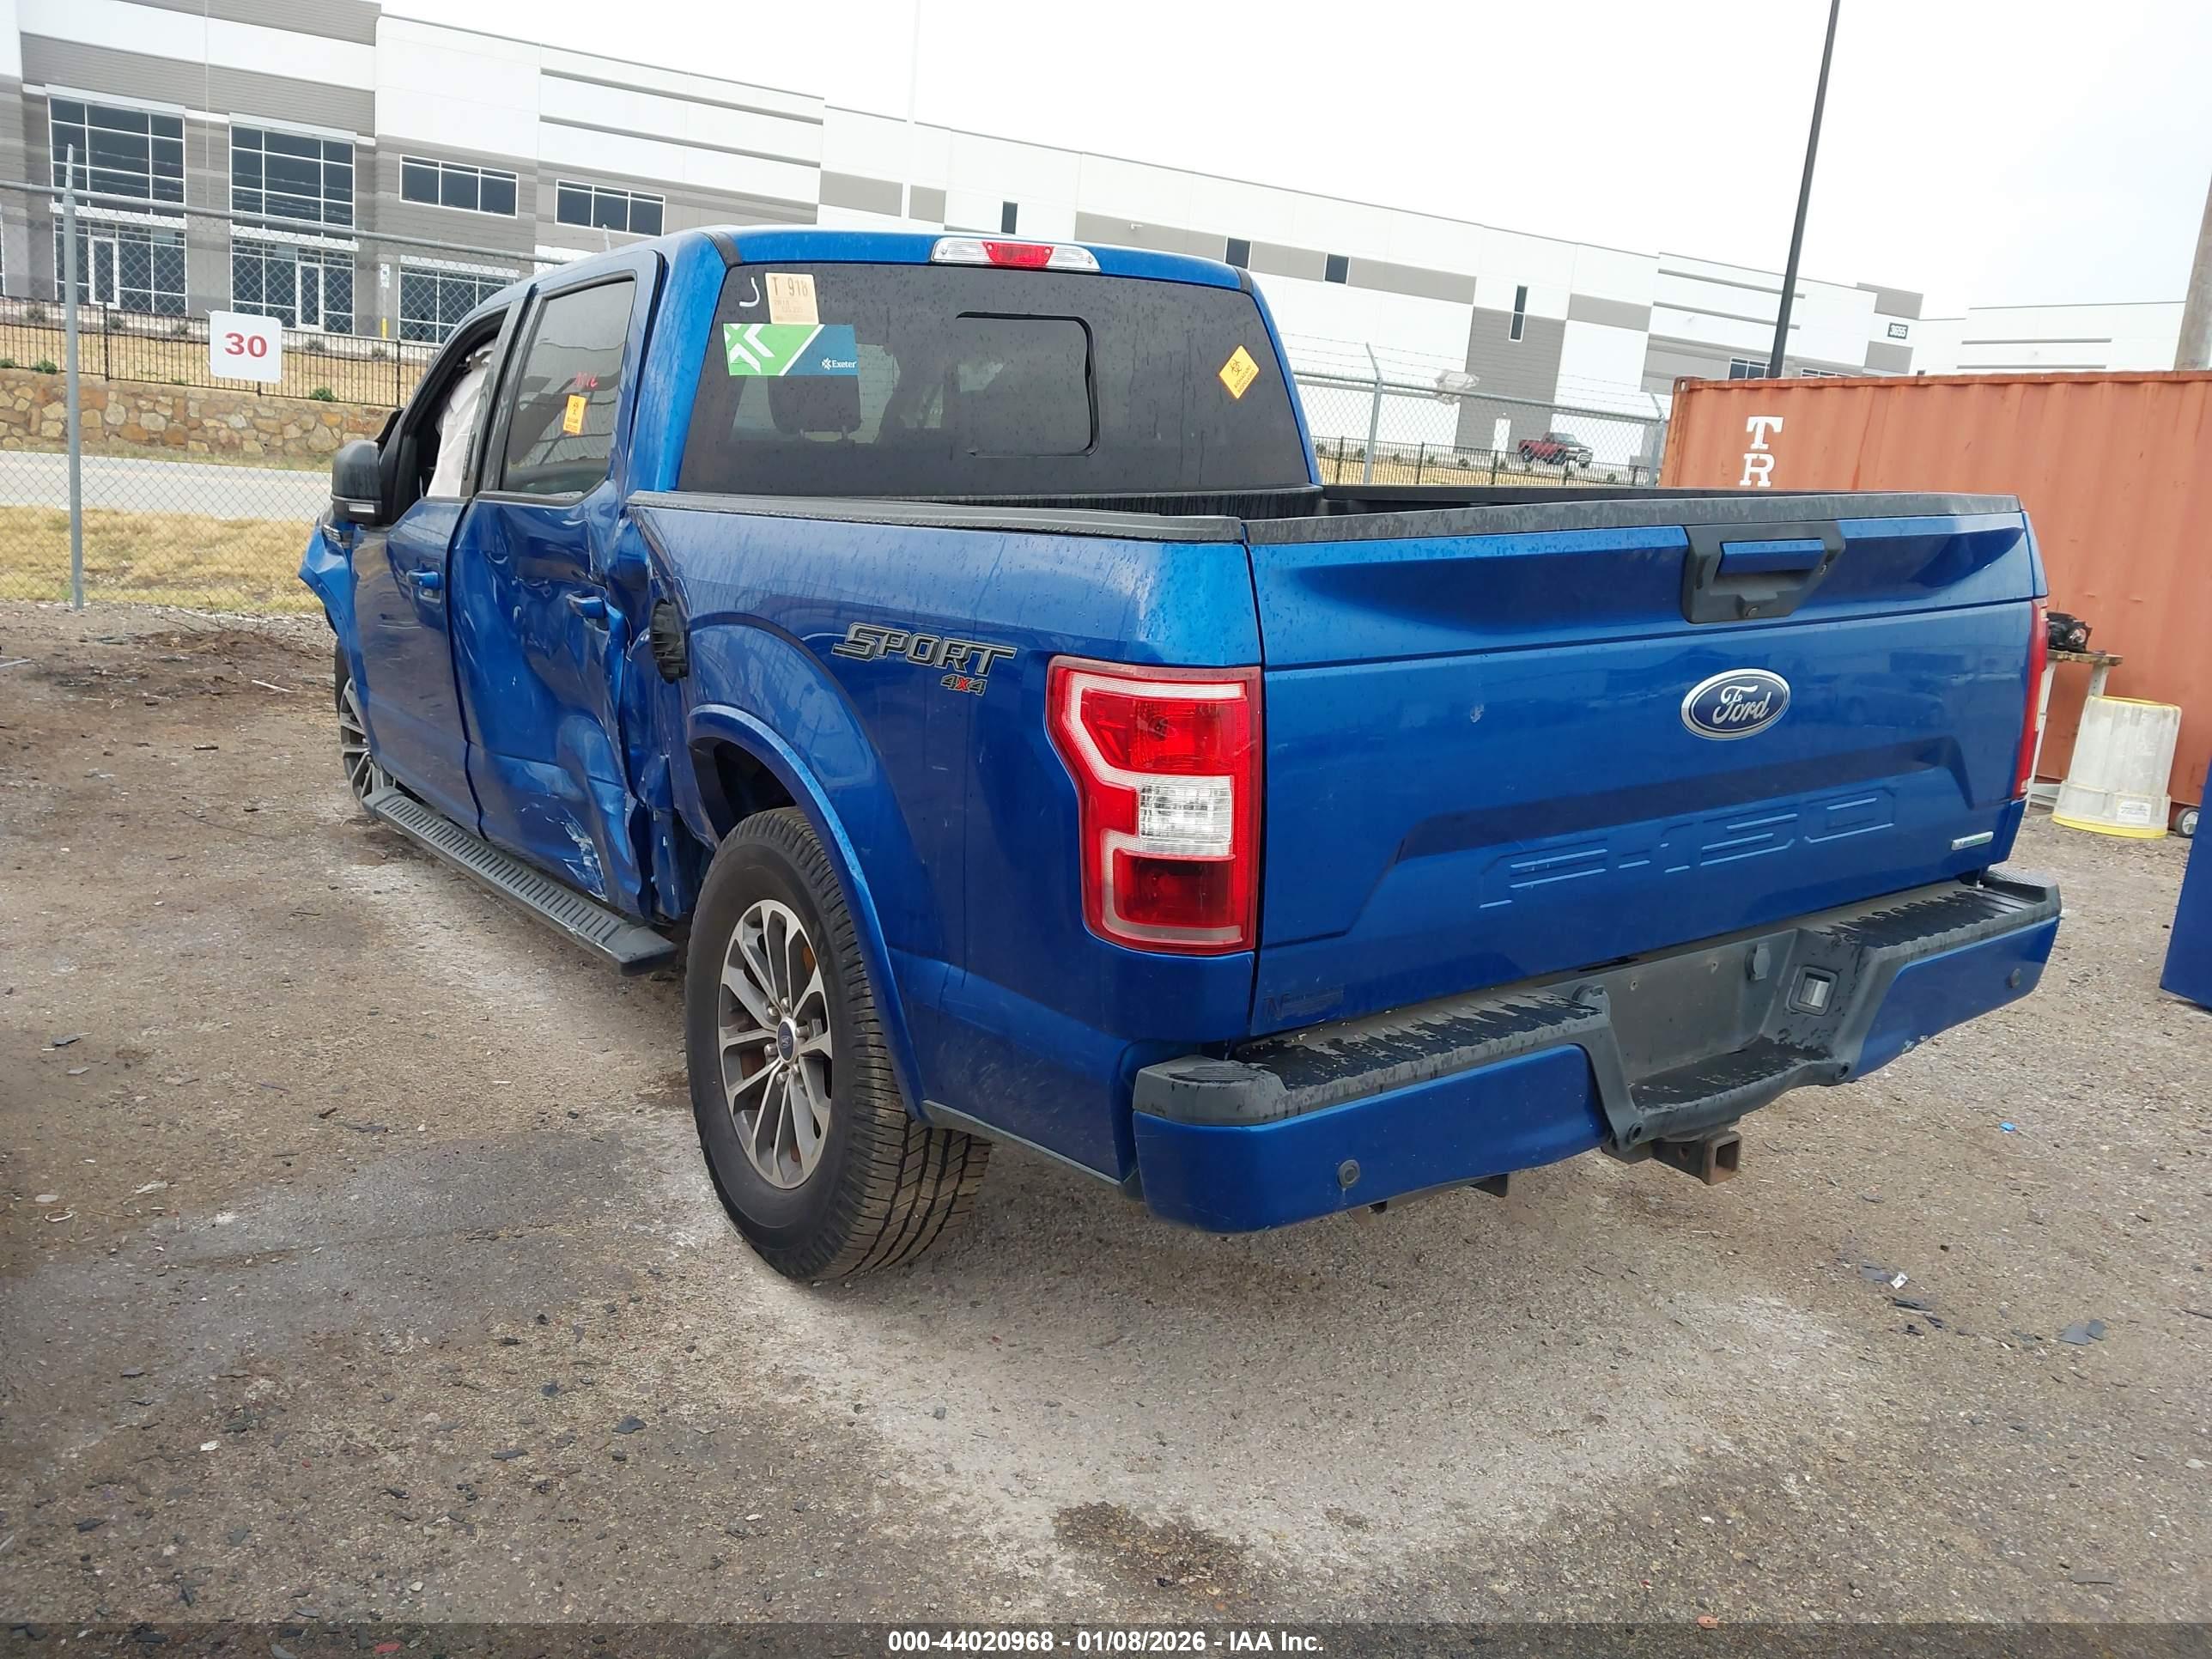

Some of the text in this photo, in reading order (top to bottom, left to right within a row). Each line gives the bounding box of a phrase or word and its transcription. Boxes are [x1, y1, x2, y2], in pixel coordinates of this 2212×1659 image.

[224, 332, 268, 358] 30
[831, 359, 857, 368] Exeter
[831, 622, 1018, 677] SPORT
[1712, 684, 1772, 724] Ford
[1479, 787, 1896, 908] F-150
